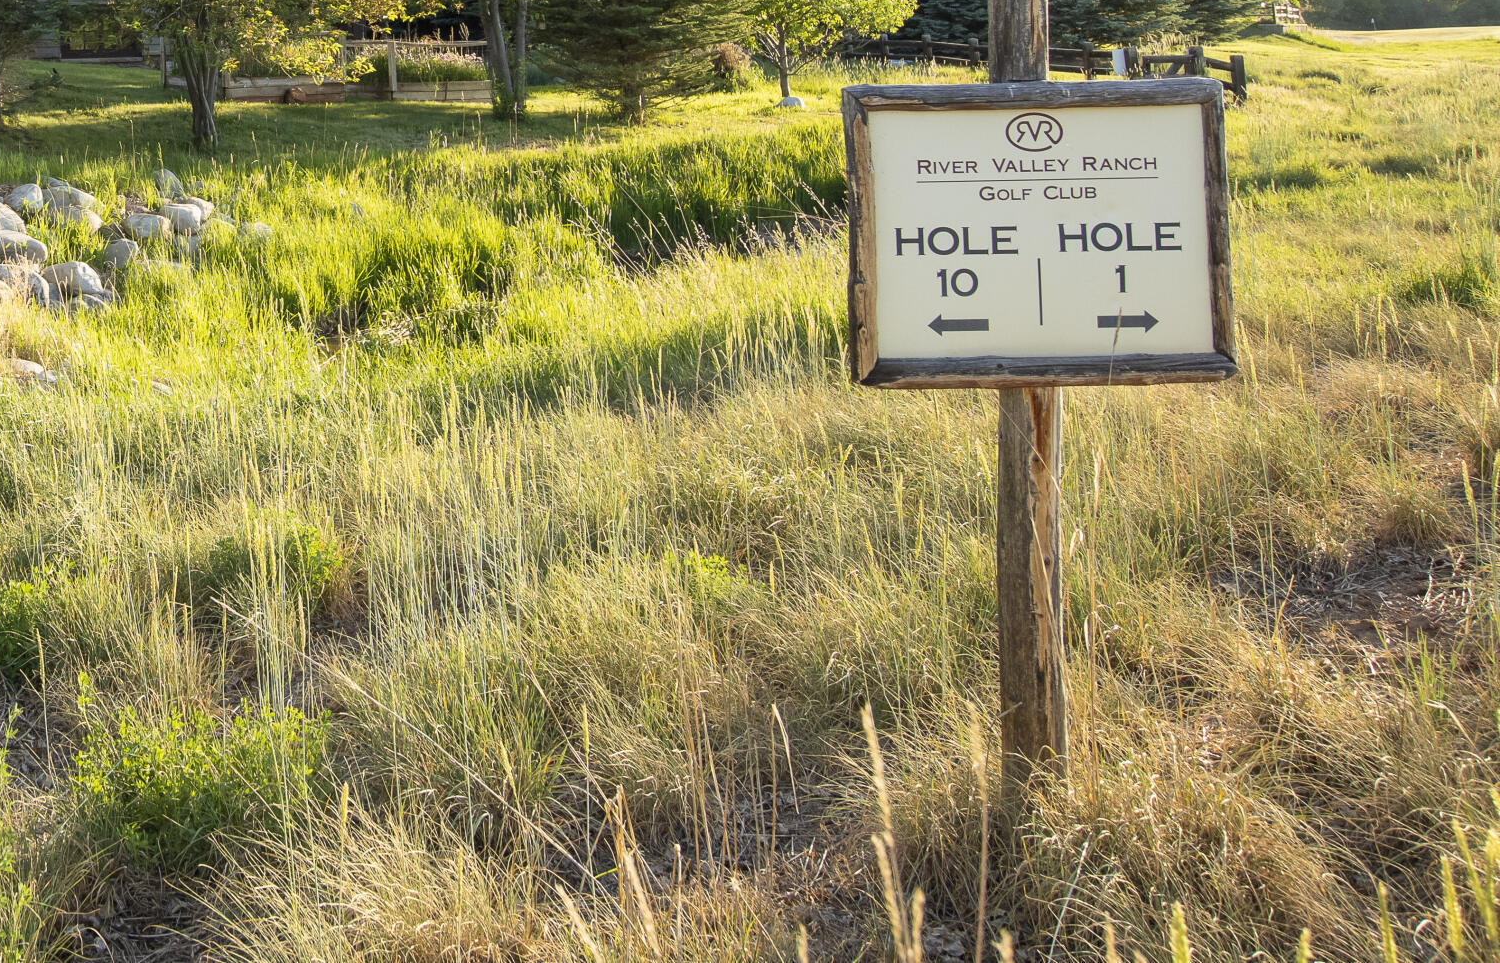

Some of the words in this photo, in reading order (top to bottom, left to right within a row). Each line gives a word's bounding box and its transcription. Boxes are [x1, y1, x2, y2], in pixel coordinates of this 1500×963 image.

[916, 159, 979, 175] RIVER
[991, 158, 1070, 173] VALLEY
[1082, 156, 1158, 172] RANCH
[978, 185, 1033, 201] GOLF
[1043, 185, 1098, 200] CLUB
[894, 225, 1019, 257] HOLE
[1057, 221, 1183, 253] HOLE
[936, 267, 980, 298] 10
[1114, 263, 1128, 294] 1
